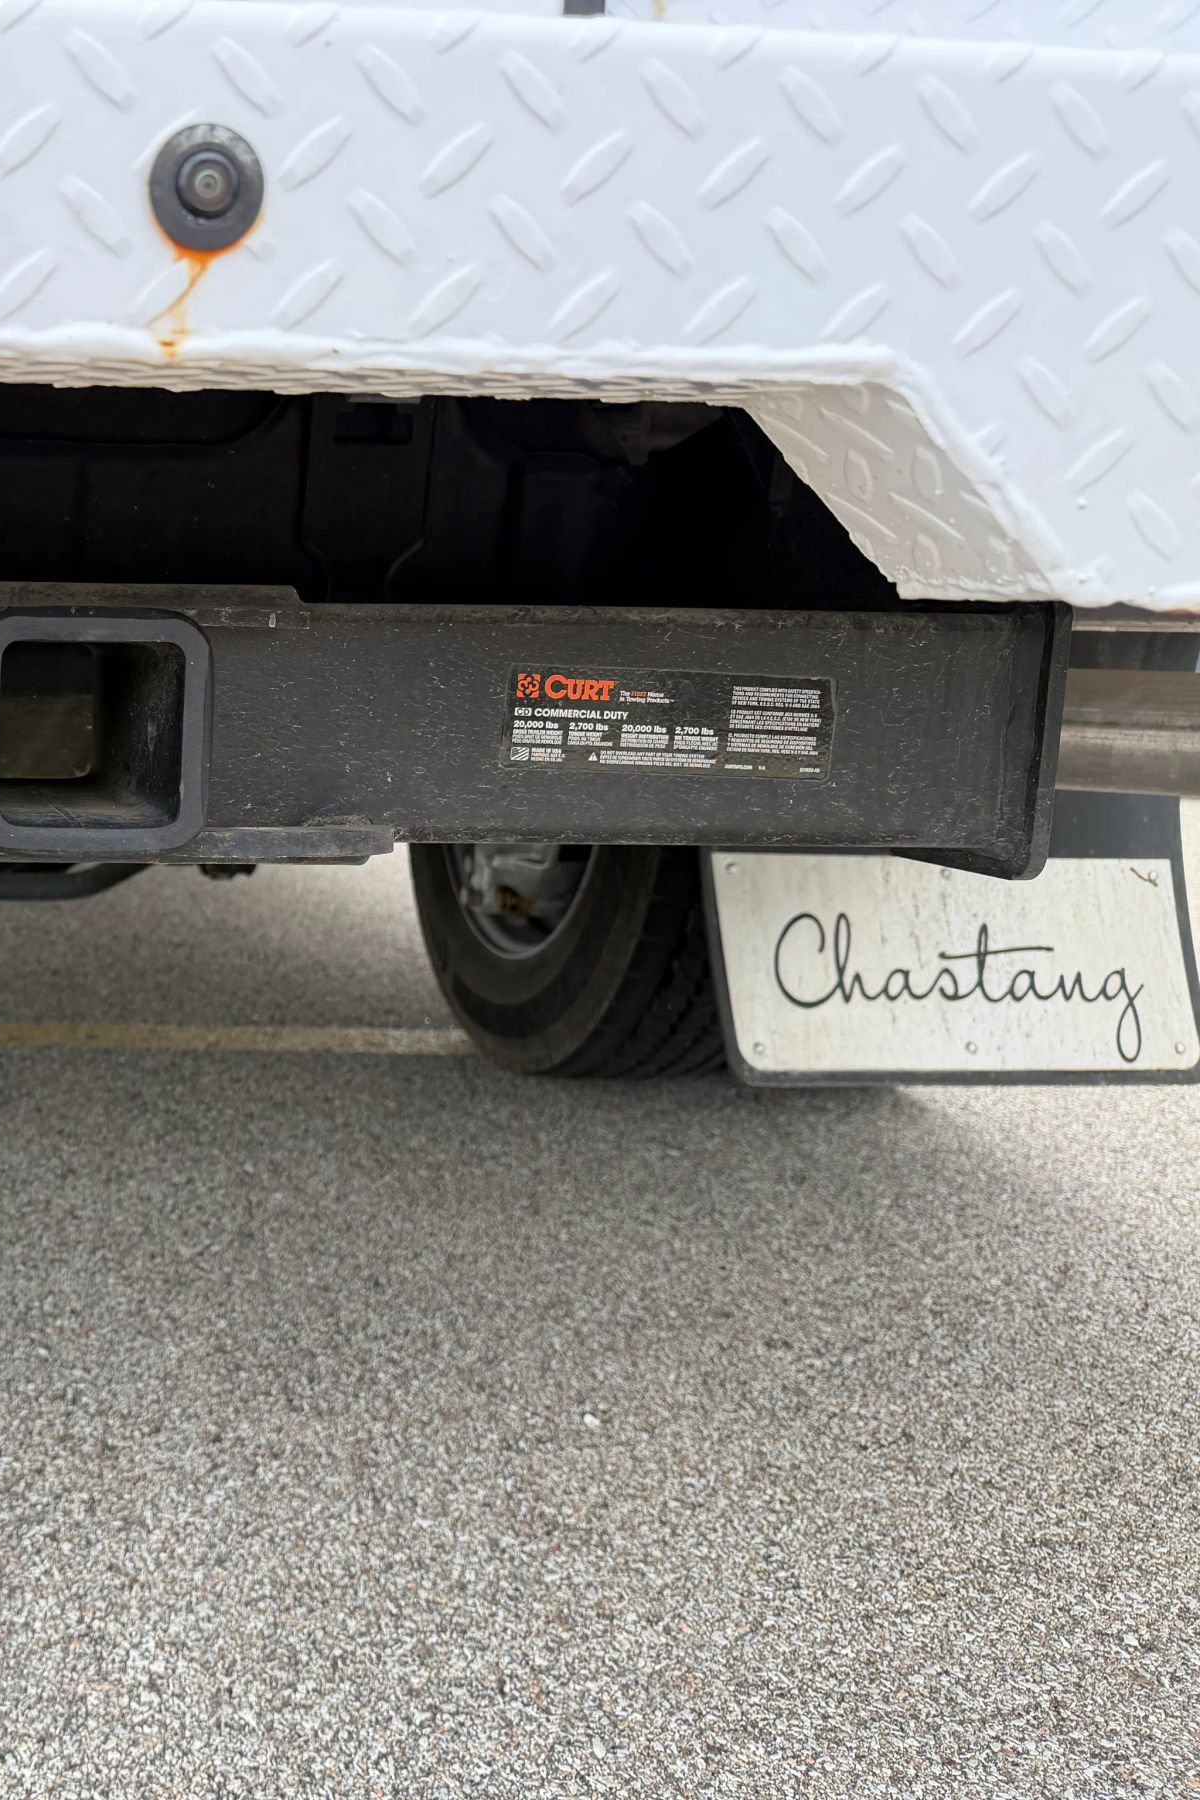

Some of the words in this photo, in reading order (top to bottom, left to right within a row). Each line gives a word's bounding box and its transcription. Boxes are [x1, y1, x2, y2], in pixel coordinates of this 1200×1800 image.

[545, 675, 615, 700] CURT
[517, 708, 529, 716] CD
[535, 708, 601, 719] COMMERCIAL
[603, 711, 628, 720] DUTY
[514, 720, 543, 729] 20,000
[569, 722, 593, 731] 2,700
[622, 724, 651, 733] 20,000
[675, 727, 699, 736] 2,700
[773, 912, 1145, 1063] Chastang
